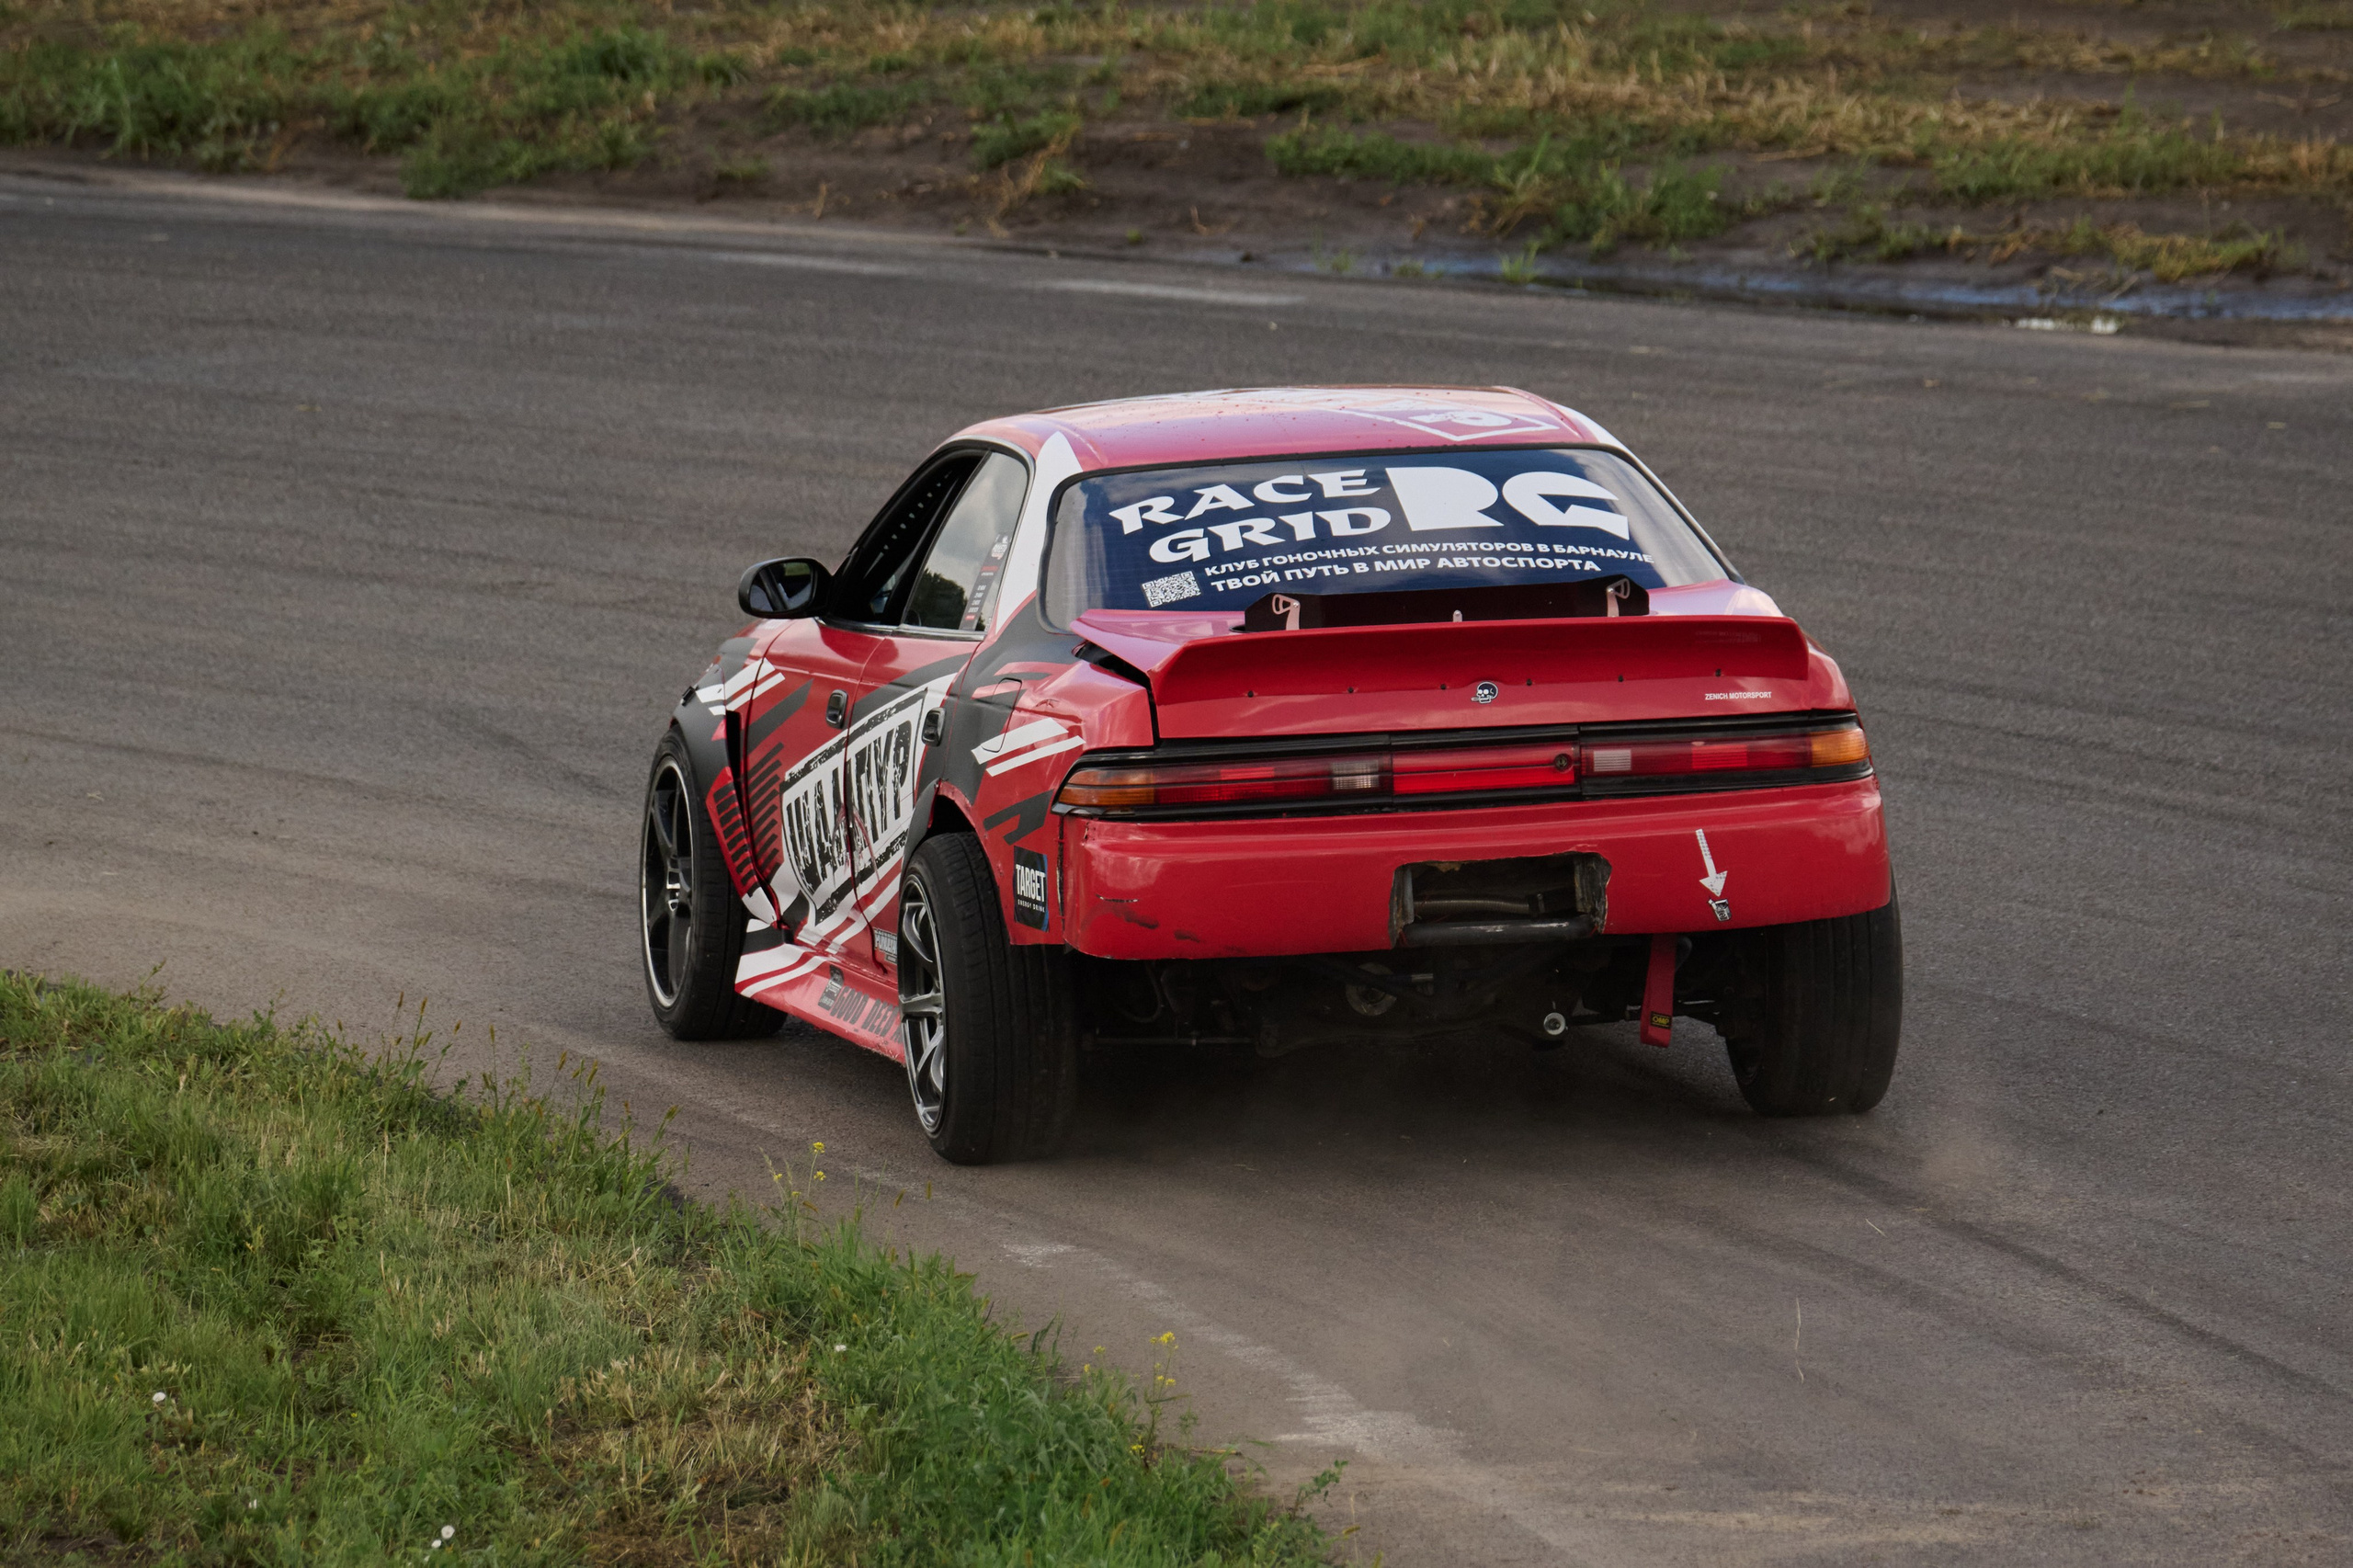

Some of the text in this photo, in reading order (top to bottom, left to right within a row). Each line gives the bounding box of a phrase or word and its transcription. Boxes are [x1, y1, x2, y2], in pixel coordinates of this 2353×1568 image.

[1108, 469, 1381, 535] RACE
[1149, 507, 1391, 562] GRID
[1205, 541, 1654, 576] КЛУБ ГОНОЧНЫХ СИМУЛЯТОРОВ В БАРНАУЛЕ
[1211, 556, 1602, 592] ТВОЙ ПУТЬ В МИР АВТОСПОРТА
[1729, 691, 1772, 699] MOTORSPORT
[1016, 864, 1046, 903] TARGET
[1017, 899, 1045, 913] ENERGY DRINK
